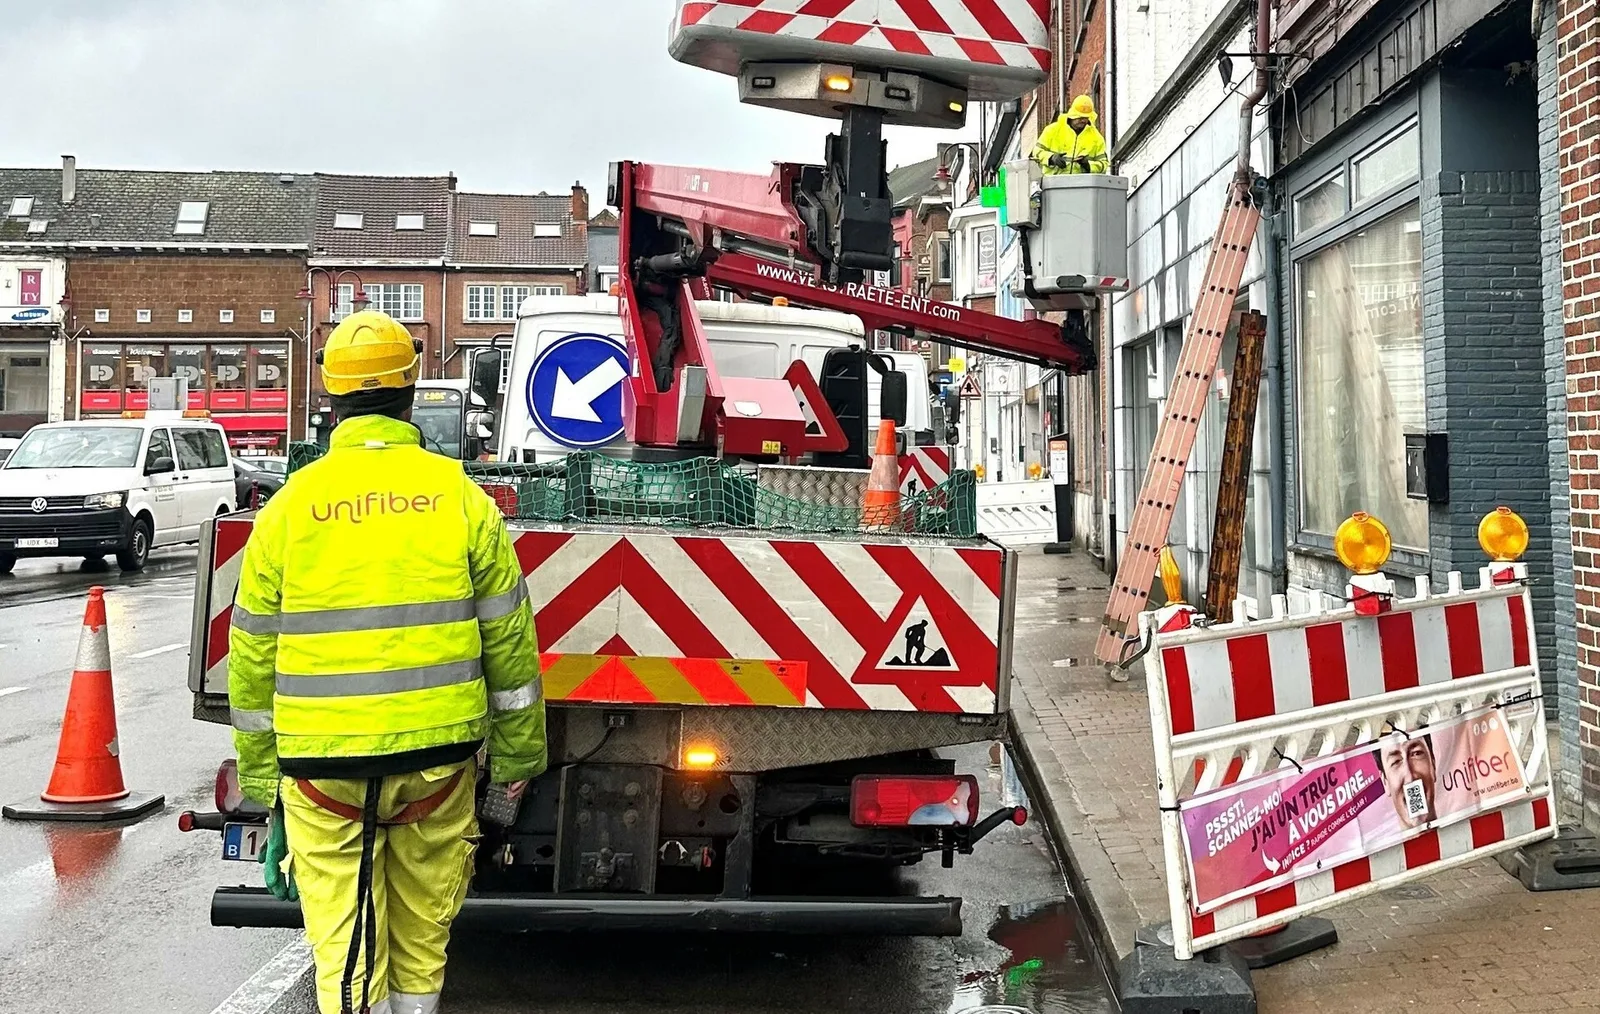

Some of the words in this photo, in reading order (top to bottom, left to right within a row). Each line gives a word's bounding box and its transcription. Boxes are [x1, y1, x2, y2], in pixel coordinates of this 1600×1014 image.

[311, 491, 445, 524] unifiber
[1442, 751, 1509, 792] unifiber
[1205, 798, 1246, 840] PSSST!
[1207, 788, 1283, 858] SCANNEZ-MOI
[1250, 815, 1276, 853] J'AI
[1276, 795, 1300, 828] UN
[1298, 766, 1339, 808] TRUC
[1288, 819, 1301, 845] À
[1299, 794, 1338, 834] VOUS
[227, 844, 239, 856] B
[247, 830, 258, 856] 1
